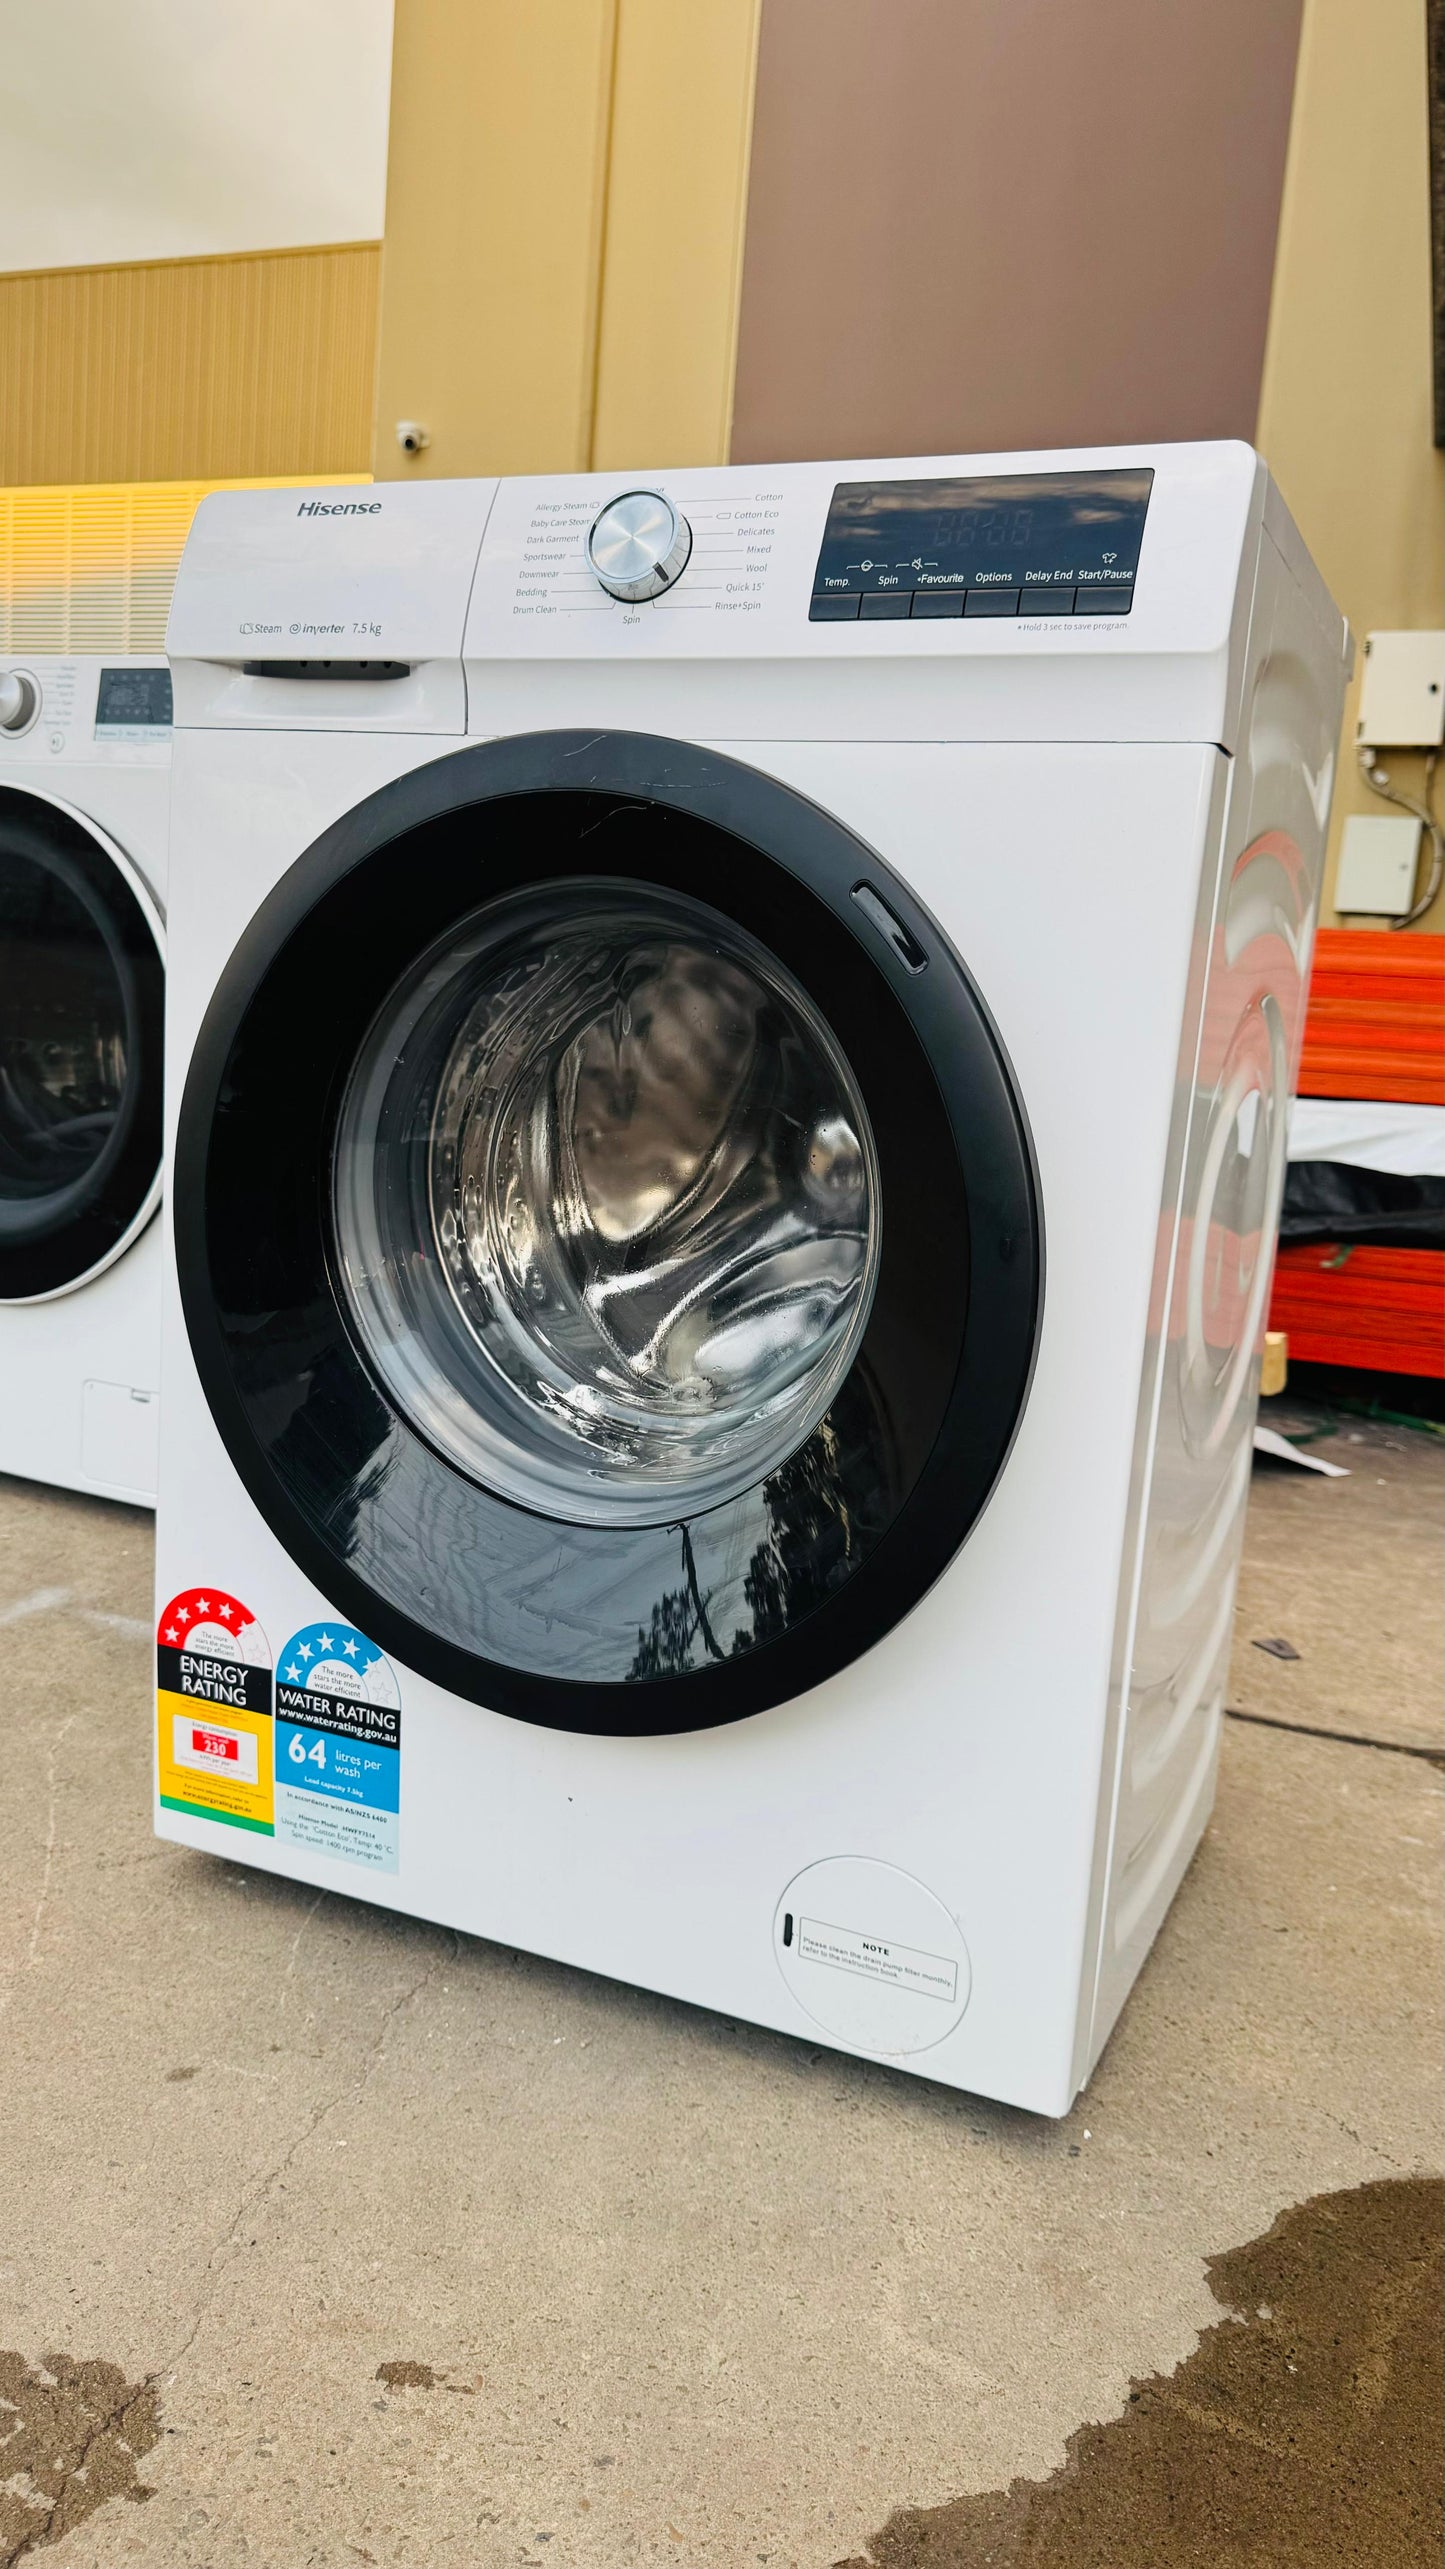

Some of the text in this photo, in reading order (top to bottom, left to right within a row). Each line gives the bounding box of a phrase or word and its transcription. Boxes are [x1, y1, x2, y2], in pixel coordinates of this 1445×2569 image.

[755, 493, 783, 502] Cotton
[297, 501, 382, 517] Hisense
[536, 502, 587, 512] Allergy Steam
[734, 510, 779, 519] Cotton Eco
[531, 519, 549, 528] Baby
[550, 519, 567, 527] Care
[737, 527, 775, 536] Delicates
[527, 535, 579, 544] Dark Garment
[747, 545, 772, 554] Mixed
[523, 552, 566, 561] Sportswear
[746, 564, 768, 572] Wool
[1078, 568, 1133, 581] Start/Pause
[519, 571, 559, 579] Downwear
[878, 574, 899, 587] Spin
[975, 572, 1012, 584] Options
[1025, 569, 1073, 584] Delay End
[516, 588, 548, 597] Bedding
[726, 582, 749, 593] Quick
[513, 606, 534, 614] Drum
[622, 616, 641, 626] Spin
[254, 623, 382, 636] Steam inverter 7.5 kg
[202, 1631, 212, 1639] The
[195, 1644, 235, 1657] energy efficient
[180, 1655, 248, 1686] ENERGY
[322, 1666, 354, 1679] The more
[314, 1674, 361, 1689] stars the more
[181, 1675, 247, 1706] RATING
[315, 1682, 361, 1698] water efficient
[279, 1688, 331, 1715] WATER
[336, 1703, 396, 1730] RATING
[279, 1707, 397, 1743] www.waterrating.gov.au
[204, 1740, 226, 1756] 230
[288, 1733, 382, 1771] 64 litres per
[335, 1764, 361, 1779] wash
[304, 1776, 320, 1785] Load
[803, 1936, 827, 1949] Please
[829, 1945, 848, 1956] clean
[850, 1950, 861, 1959] the
[863, 1954, 882, 1966] drain
[883, 1961, 903, 1972] pump
[862, 1942, 890, 1956] NOTE
[821, 1950, 828, 1958] to
[829, 1953, 840, 1962] the
[842, 1957, 879, 1973] instruction
